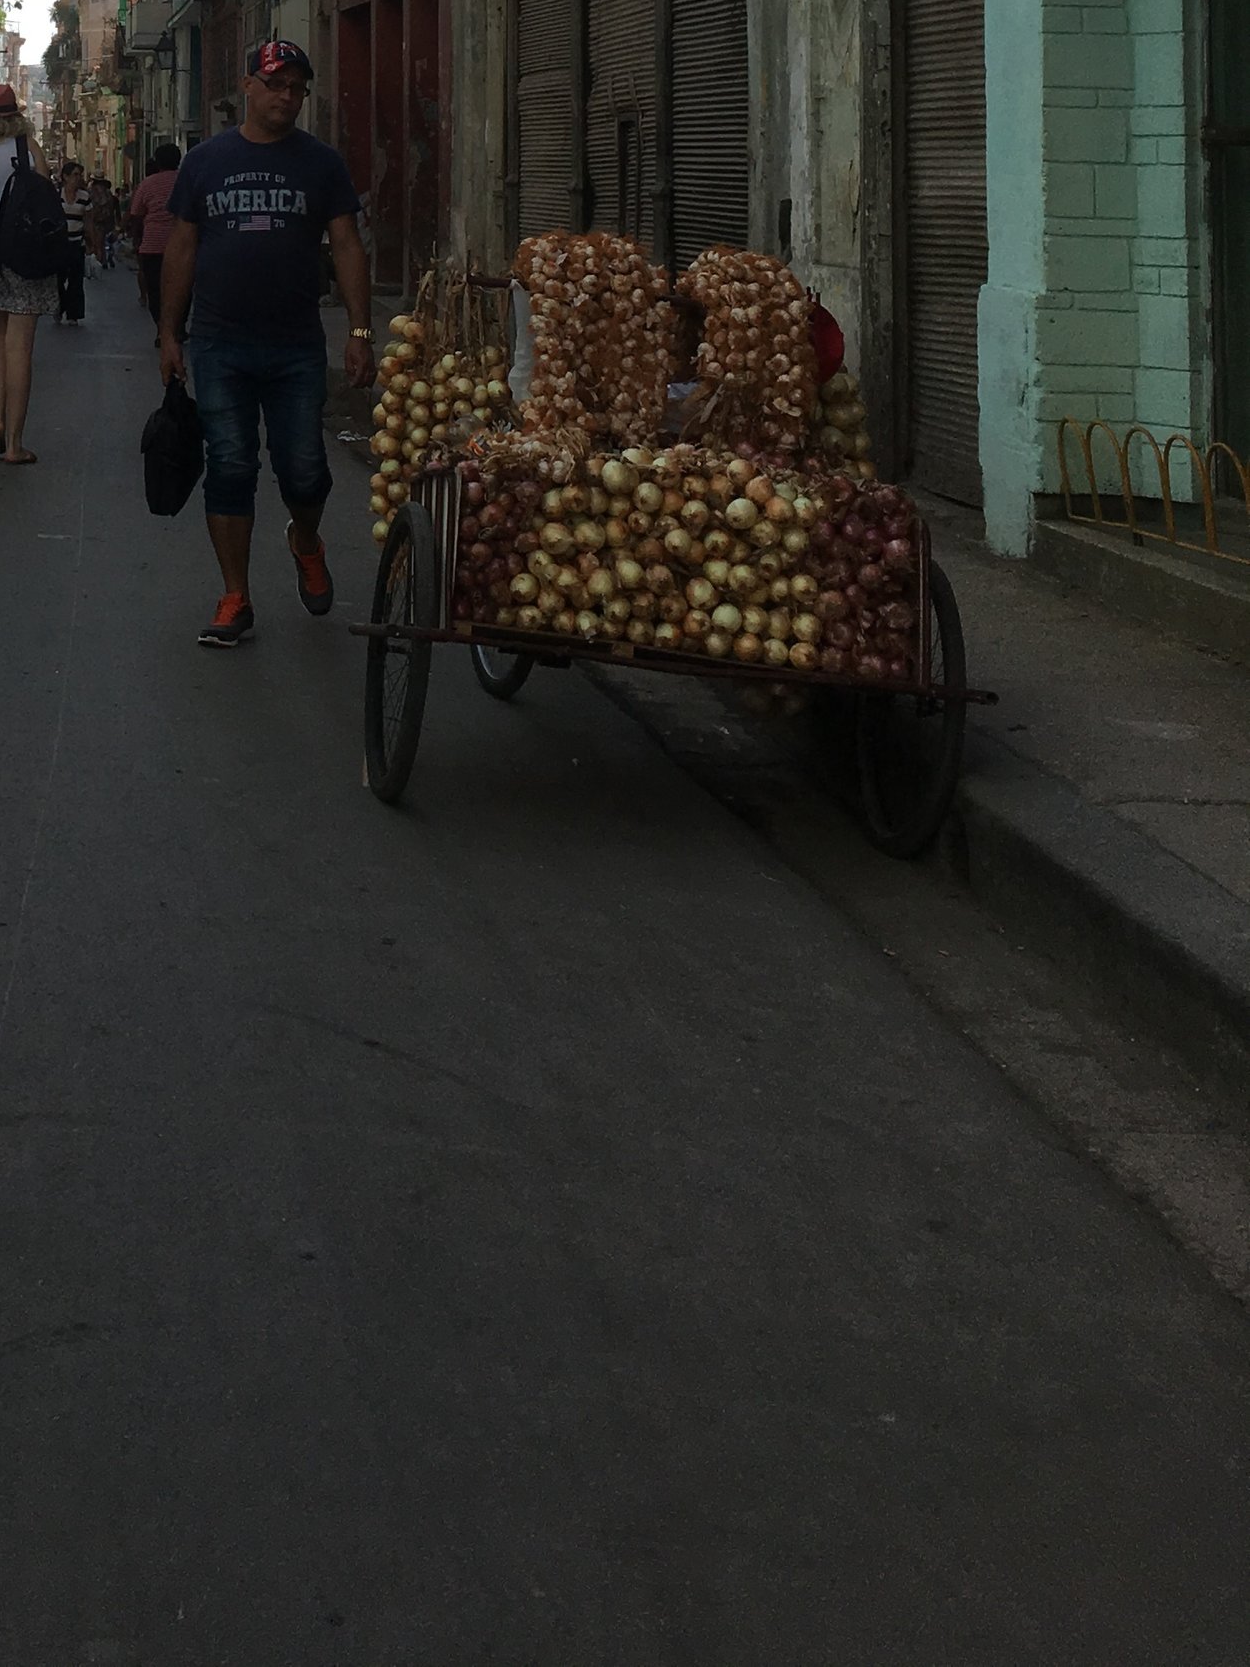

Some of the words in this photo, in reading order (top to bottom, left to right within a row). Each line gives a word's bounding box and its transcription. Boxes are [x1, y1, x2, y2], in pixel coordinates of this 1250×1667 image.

[224, 172, 270, 187] PROPERTY
[275, 174, 286, 184] OF
[206, 189, 308, 217] AMERICA
[226, 220, 236, 229] 17
